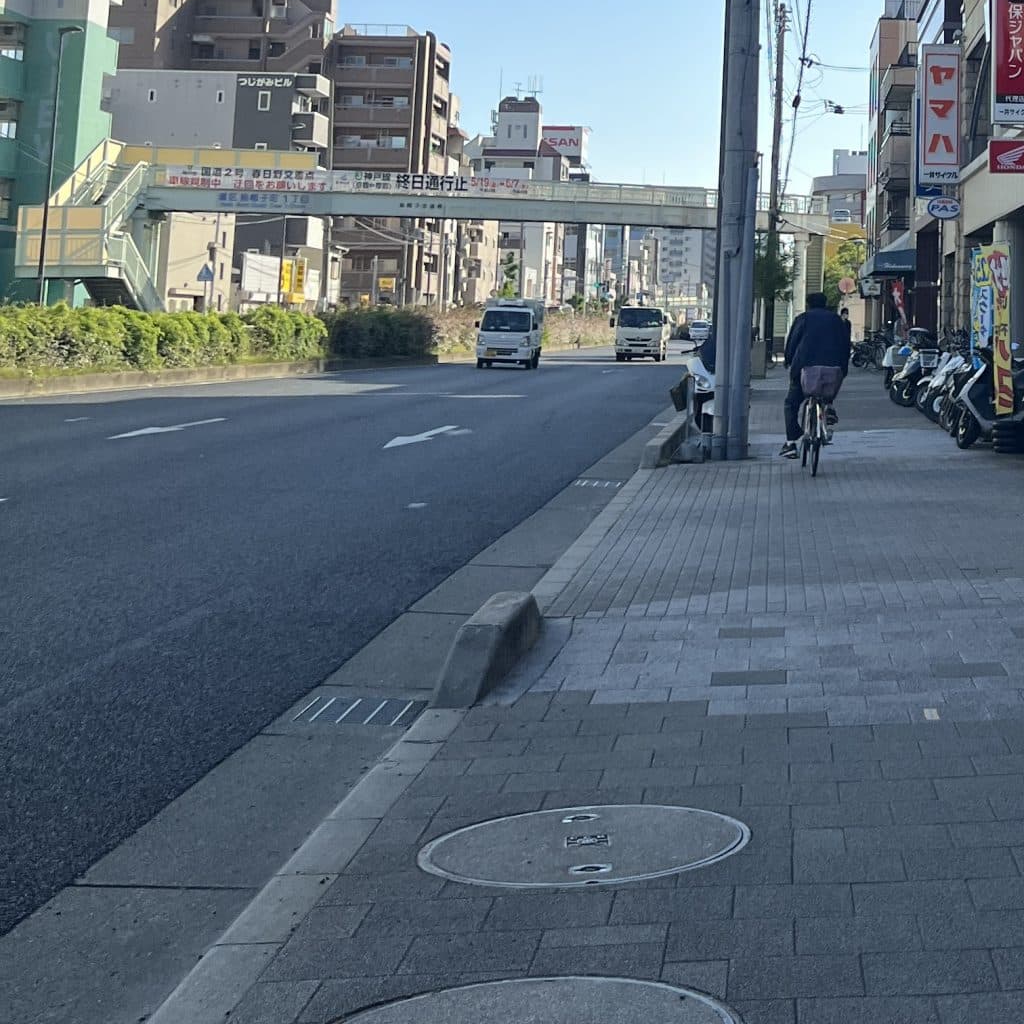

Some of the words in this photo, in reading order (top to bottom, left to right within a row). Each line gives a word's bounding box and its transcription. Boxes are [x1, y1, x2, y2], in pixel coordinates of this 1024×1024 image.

[1008, 2, 1024, 79] 保ジャパン
[238, 77, 292, 87] つじがみビル
[928, 65, 955, 153] ヤマハ
[543, 137, 579, 147] SAN
[396, 174, 468, 192] 終日通行止
[931, 204, 959, 212] PAS
